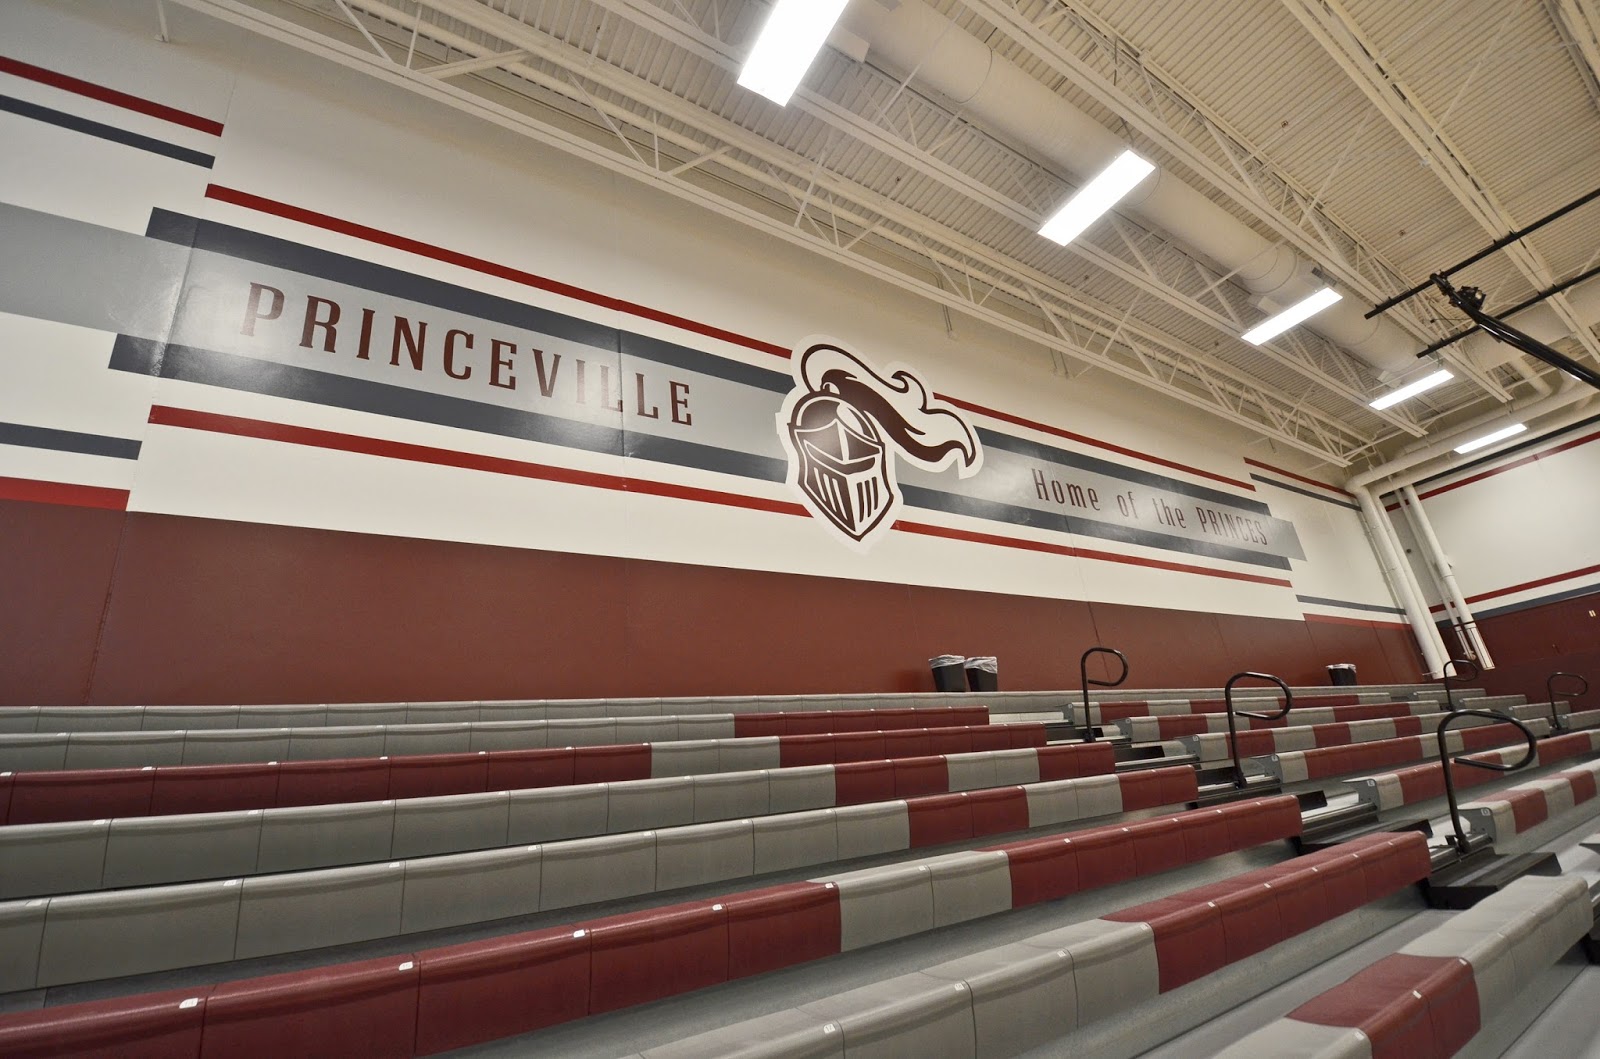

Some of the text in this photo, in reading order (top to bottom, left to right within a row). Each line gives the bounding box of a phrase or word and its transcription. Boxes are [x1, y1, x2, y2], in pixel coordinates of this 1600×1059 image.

[240, 282, 692, 425] PRINCEVILLE
[1031, 468, 1268, 546] Home of the PRINCES
